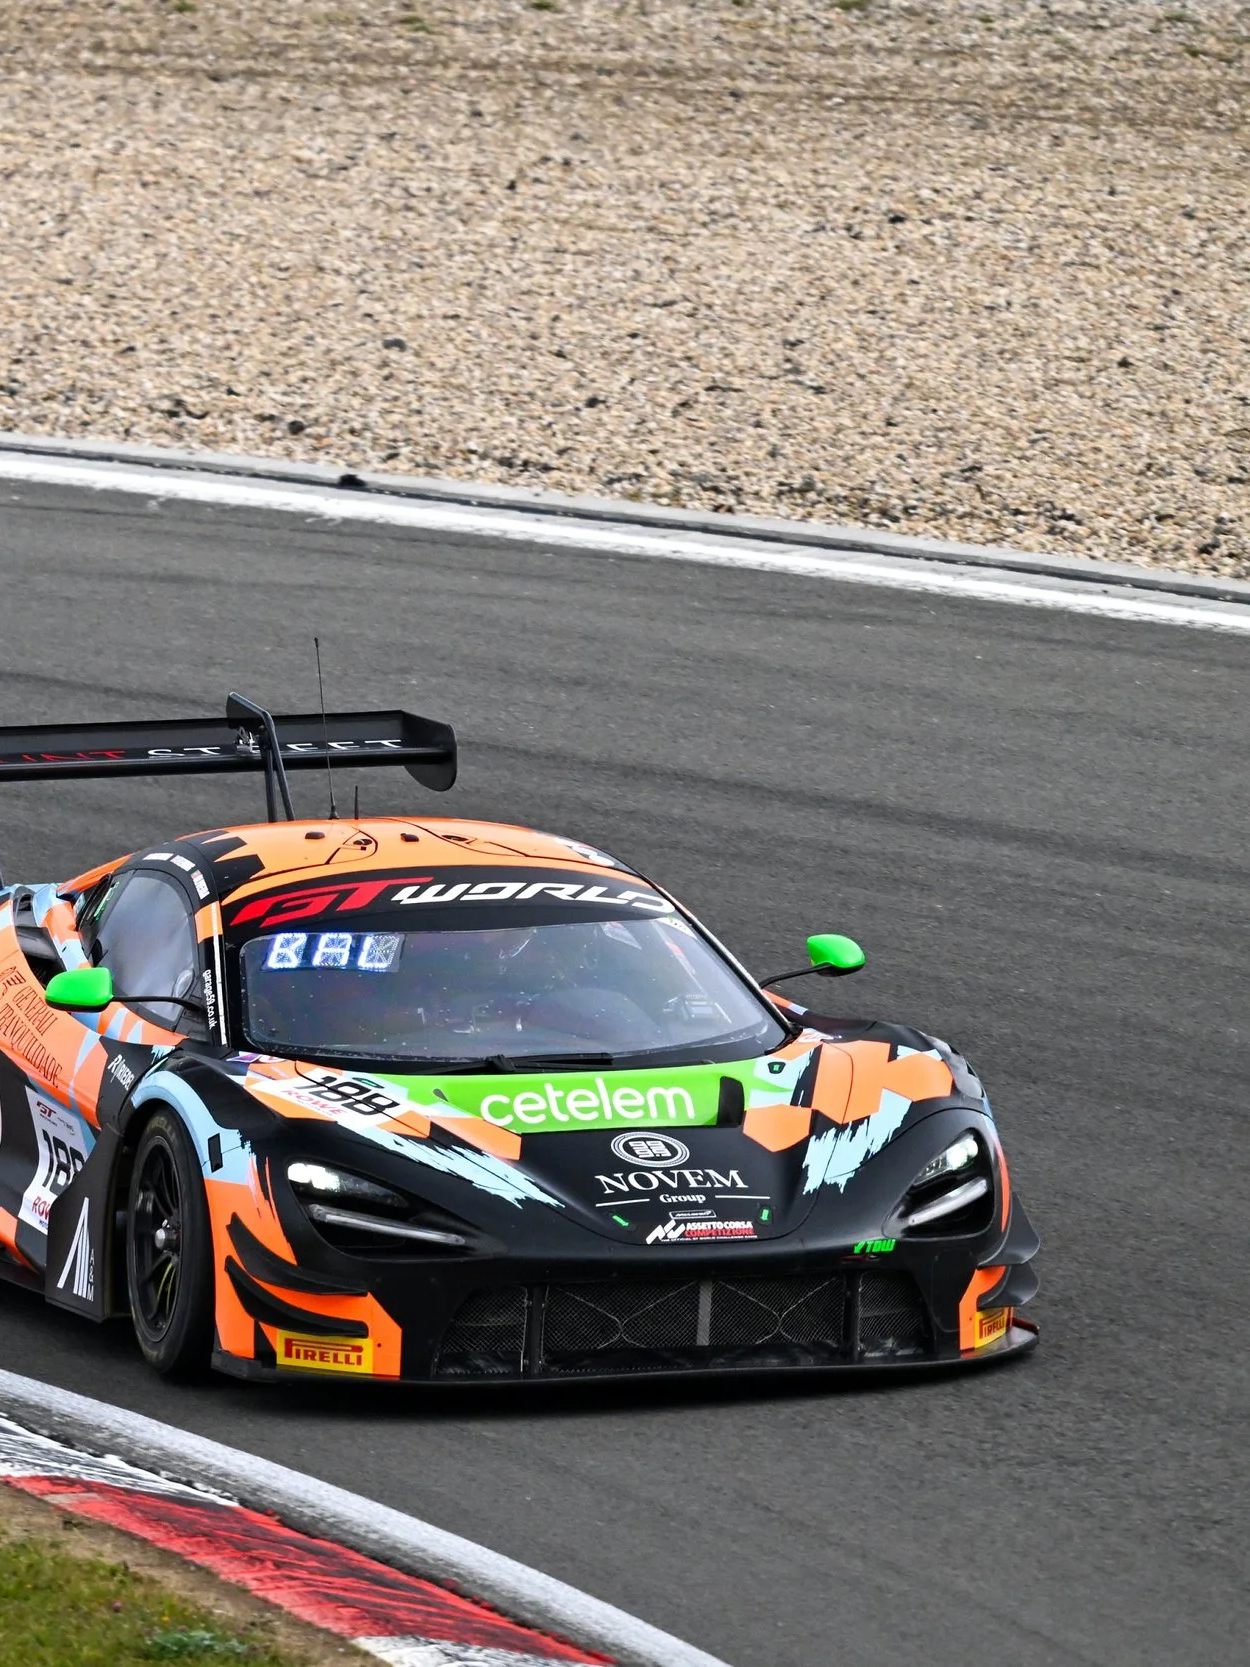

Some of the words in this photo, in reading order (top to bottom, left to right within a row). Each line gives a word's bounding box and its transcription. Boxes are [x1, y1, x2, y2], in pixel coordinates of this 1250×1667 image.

[391, 882, 676, 913] WORLD
[12, 985, 58, 1037] GENERALI
[280, 1089, 349, 1116] ROWE
[294, 1075, 401, 1116] 188
[480, 1077, 695, 1127] cetelem
[594, 1169, 749, 1194] NOVEM
[659, 1193, 706, 1204] Group
[684, 1228, 755, 1238] COMPETIZIONE
[686, 1221, 723, 1231] ASSETTO
[723, 1220, 754, 1229] CORSA
[865, 1239, 896, 1253] TOW
[978, 1309, 1005, 1340] PIRELLI
[284, 1337, 364, 1366] PIRELLI
